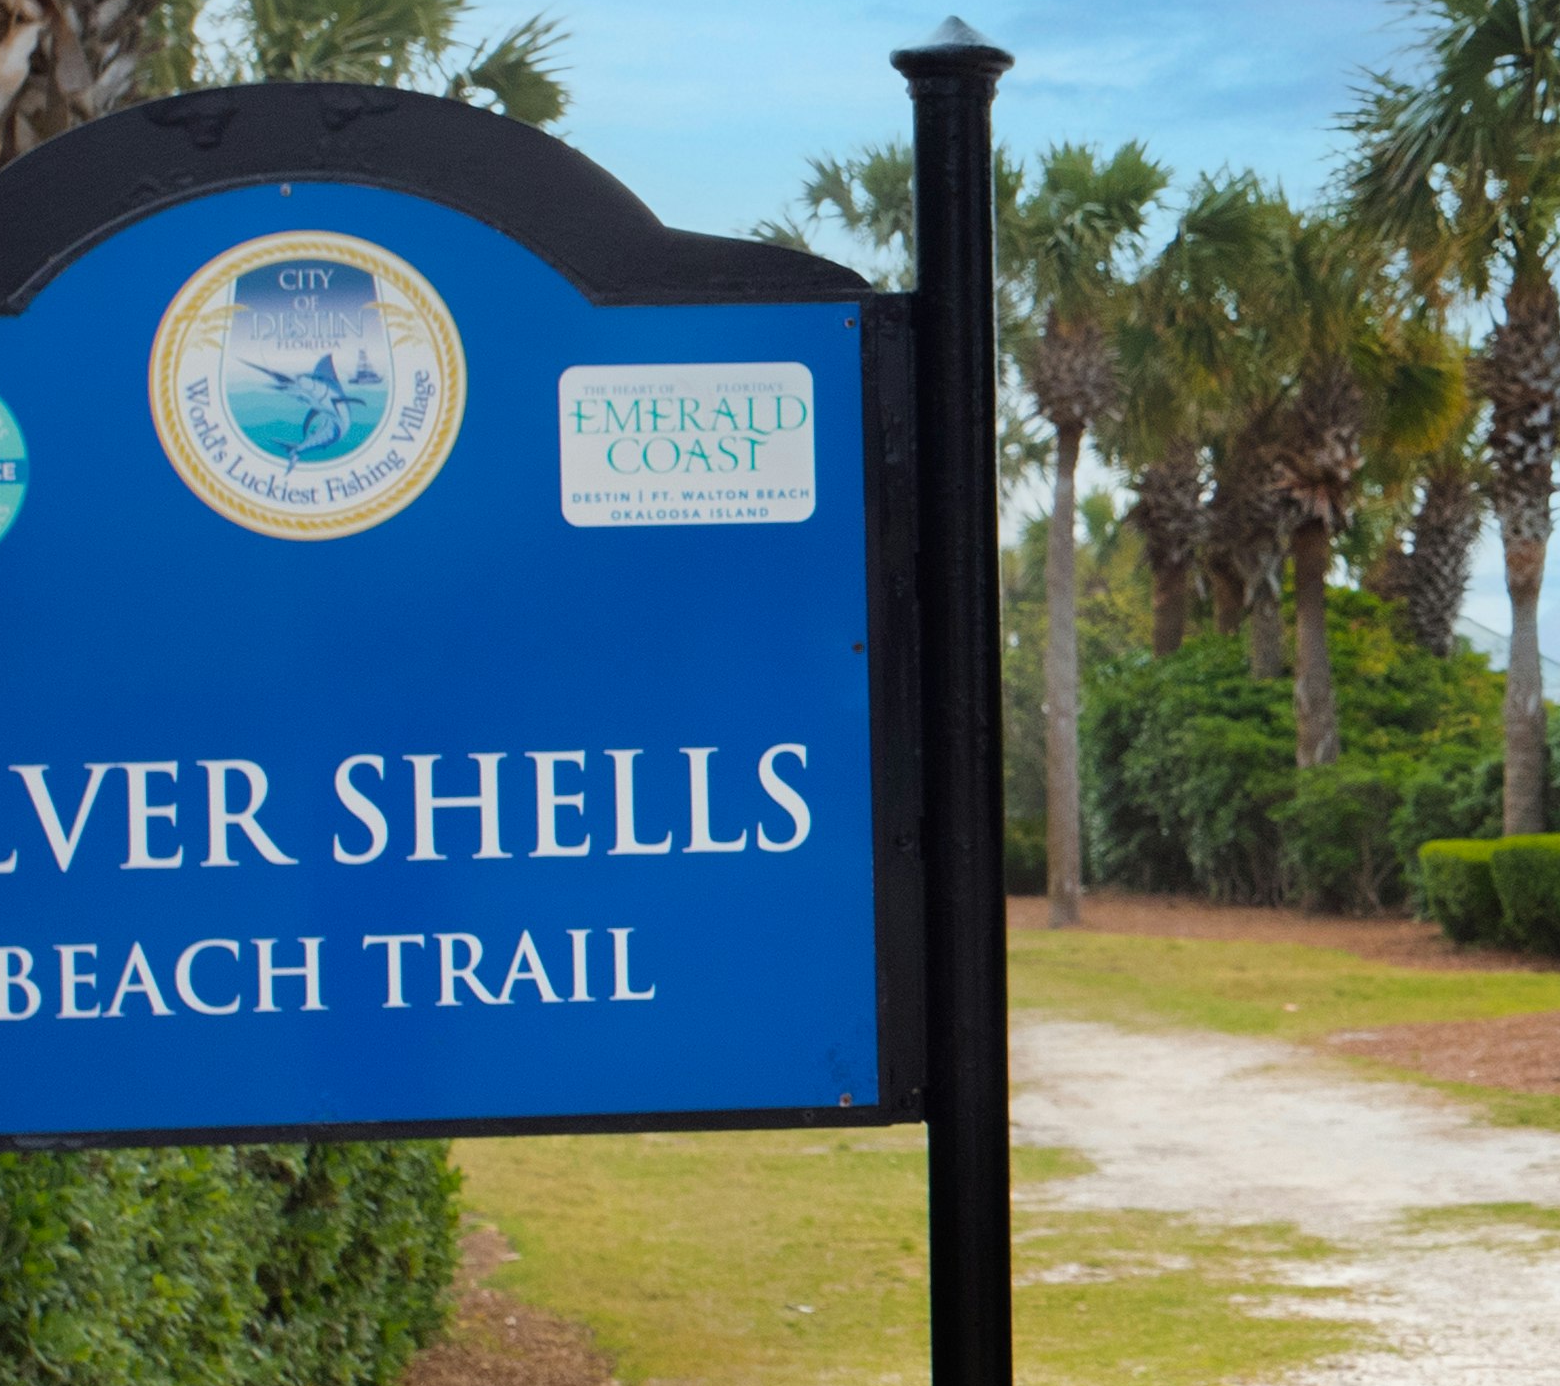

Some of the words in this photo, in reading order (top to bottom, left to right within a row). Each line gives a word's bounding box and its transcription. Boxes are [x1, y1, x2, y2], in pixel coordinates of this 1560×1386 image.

[279, 268, 334, 290] CITY
[294, 295, 319, 311] OF
[251, 312, 364, 340] DESTIN
[277, 339, 341, 349] FLORIDA
[584, 386, 607, 396] THE
[612, 385, 654, 395] HEART
[659, 384, 675, 394] OF
[716, 382, 783, 393] FLORIDA'S
[569, 394, 808, 436] EMERALD
[186, 377, 228, 463] World's
[225, 456, 320, 505] Luckiest
[325, 449, 406, 502] Fishing
[391, 370, 436, 444] Village
[607, 436, 768, 474] COAST
[572, 492, 631, 504] DESTIN
[652, 491, 674, 502] FT.
[682, 490, 749, 501] WALTON
[756, 489, 810, 500] BEACH
[610, 509, 701, 521] OKALOOSA
[710, 507, 769, 519] ISLAND
[333, 742, 812, 865] SHELLS
[362, 927, 656, 1009] TRAIL
